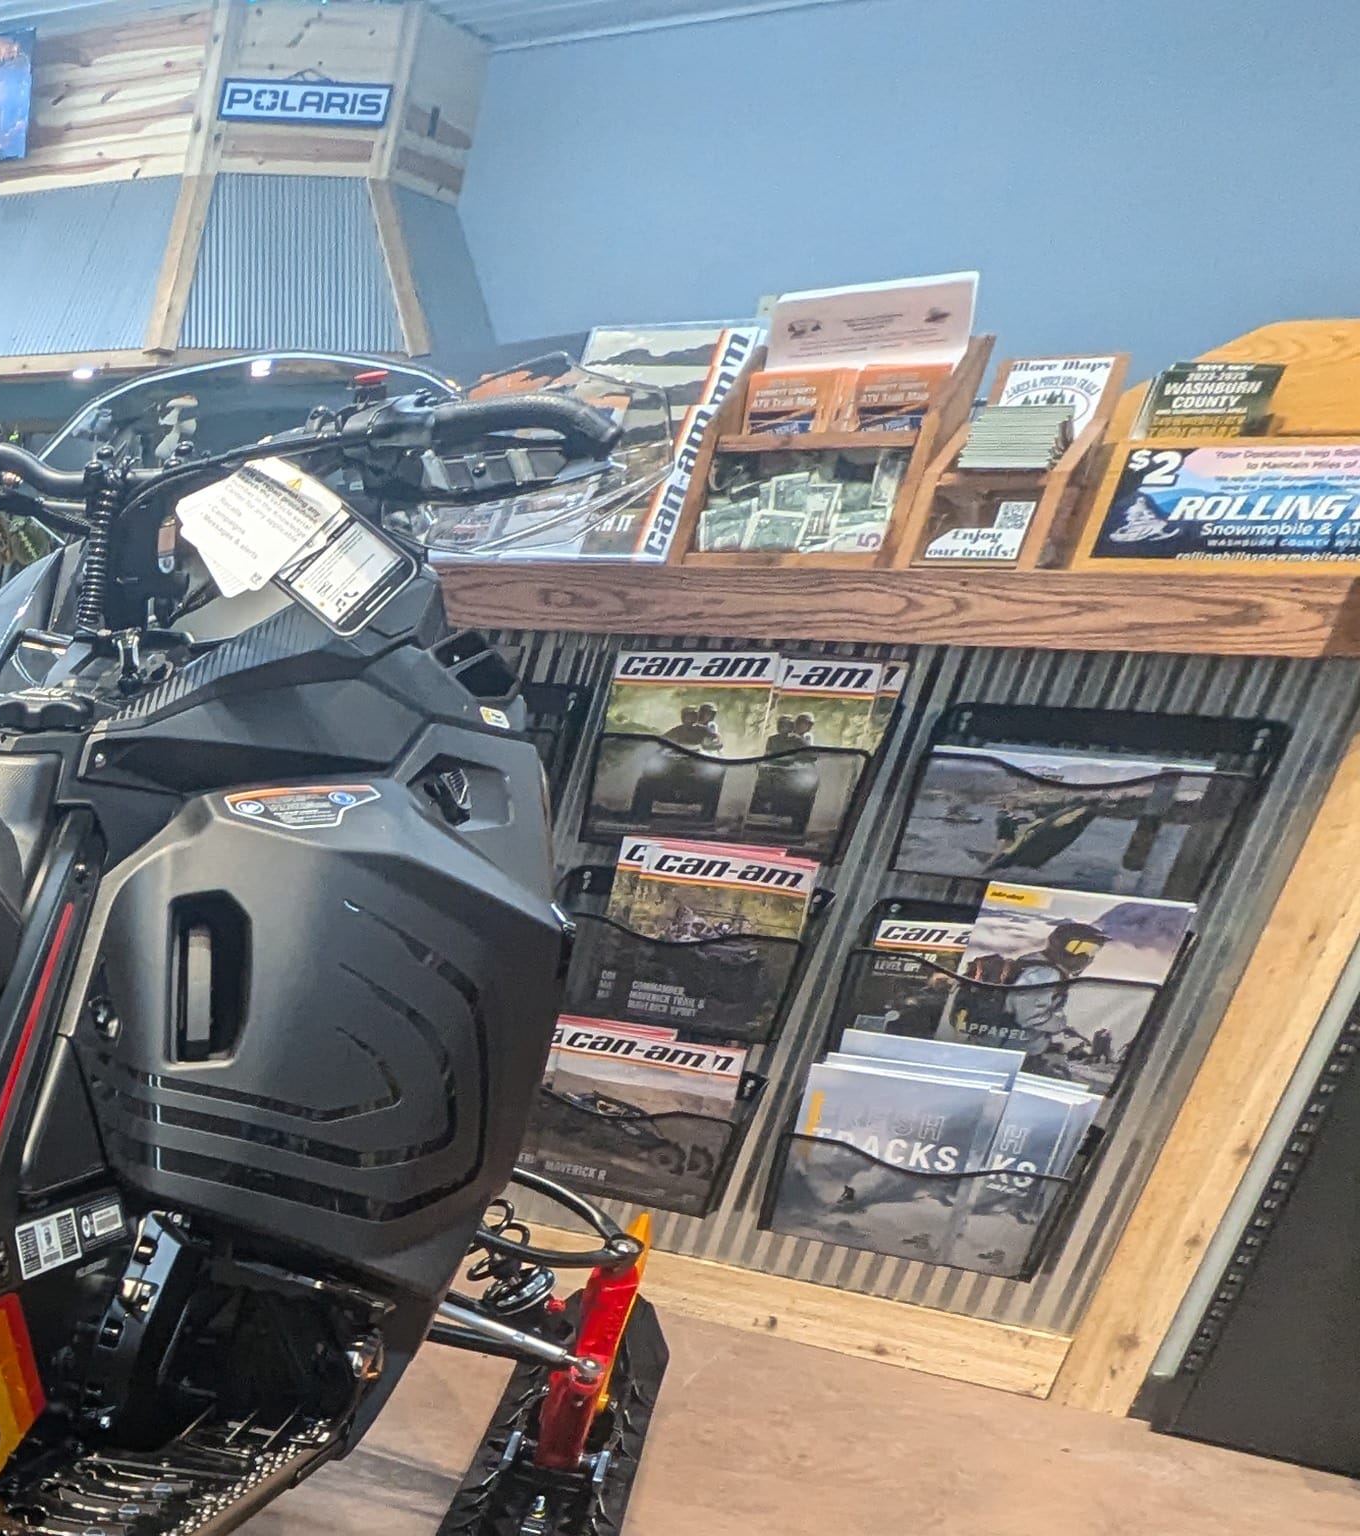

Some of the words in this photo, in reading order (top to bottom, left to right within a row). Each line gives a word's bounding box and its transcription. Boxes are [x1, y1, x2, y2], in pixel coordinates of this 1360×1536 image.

[227, 88, 383, 115] POLARIS
[1012, 360, 1060, 372] More
[1062, 359, 1111, 375] Maps
[1164, 380, 1263, 396] WASHBURN
[1171, 394, 1242, 409] COUNTY
[1215, 450, 1242, 459] Your
[1243, 449, 1302, 459] Donations
[1303, 450, 1331, 459] Help
[1128, 449, 1183, 486] $2
[1260, 461, 1309, 470] Maintain
[1311, 460, 1341, 469] Miles
[1342, 460, 1358, 469] of
[1167, 493, 1353, 521] ROLLING
[951, 528, 1003, 544] Enjoy
[1200, 522, 1315, 536] Snowmobile
[1317, 522, 1332, 536] &
[927, 548, 960, 557] our
[962, 543, 1016, 557] trails!
[1206, 537, 1276, 547] WASHBURN
[1279, 537, 1330, 547] COUNTY
[619, 655, 772, 679] can-am
[654, 853, 804, 889] can-am
[957, 1022, 1030, 1041] APPAREL
[566, 1030, 707, 1068] can-am
[812, 1127, 959, 1173] TRACKS
[544, 1160, 598, 1179] MAVERICK
